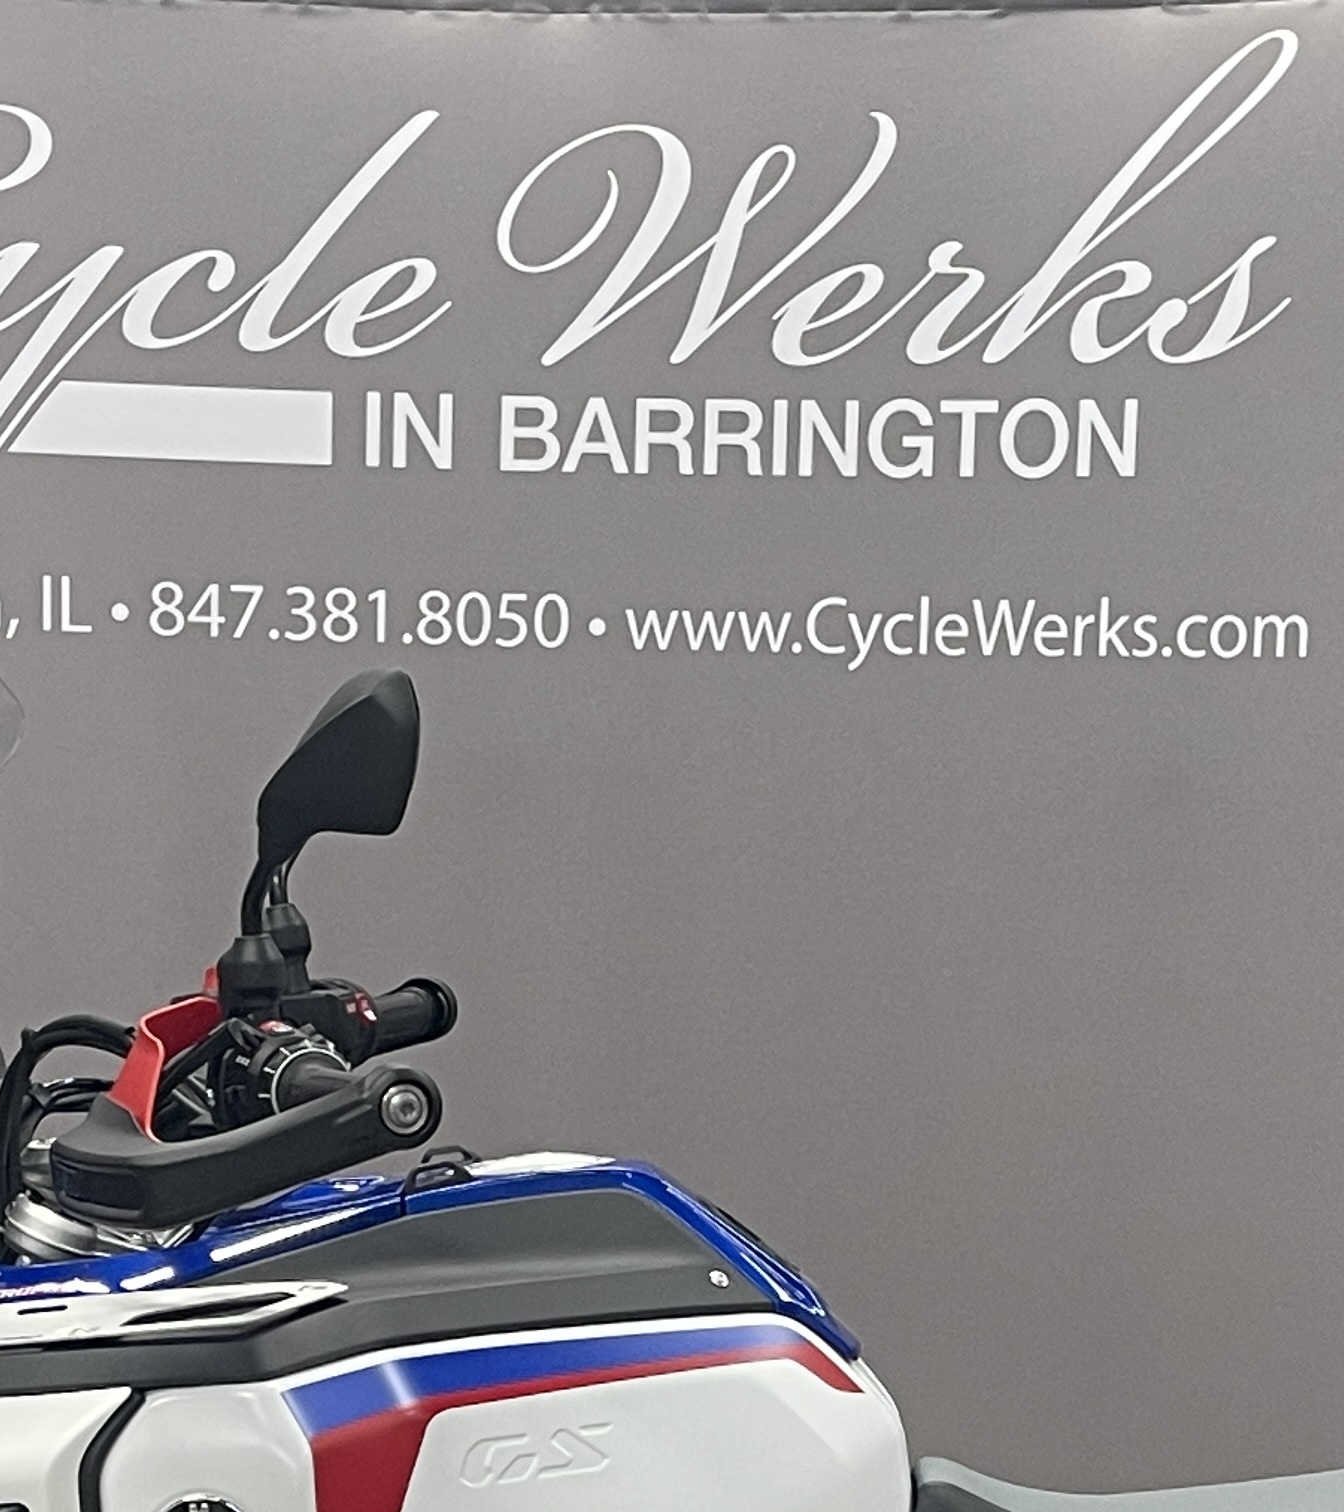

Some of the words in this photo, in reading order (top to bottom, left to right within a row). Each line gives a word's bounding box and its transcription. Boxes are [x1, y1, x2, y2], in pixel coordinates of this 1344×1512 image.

[494, 29, 1299, 367] Werks
[364, 391, 453, 471] IN
[499, 395, 1140, 480] BARRINGTON
[41, 574, 93, 633] IL
[148, 581, 570, 649] 847.381.8050
[624, 595, 1310, 671] www.CycleWerks.com
[459, 1422, 614, 1488] GS
